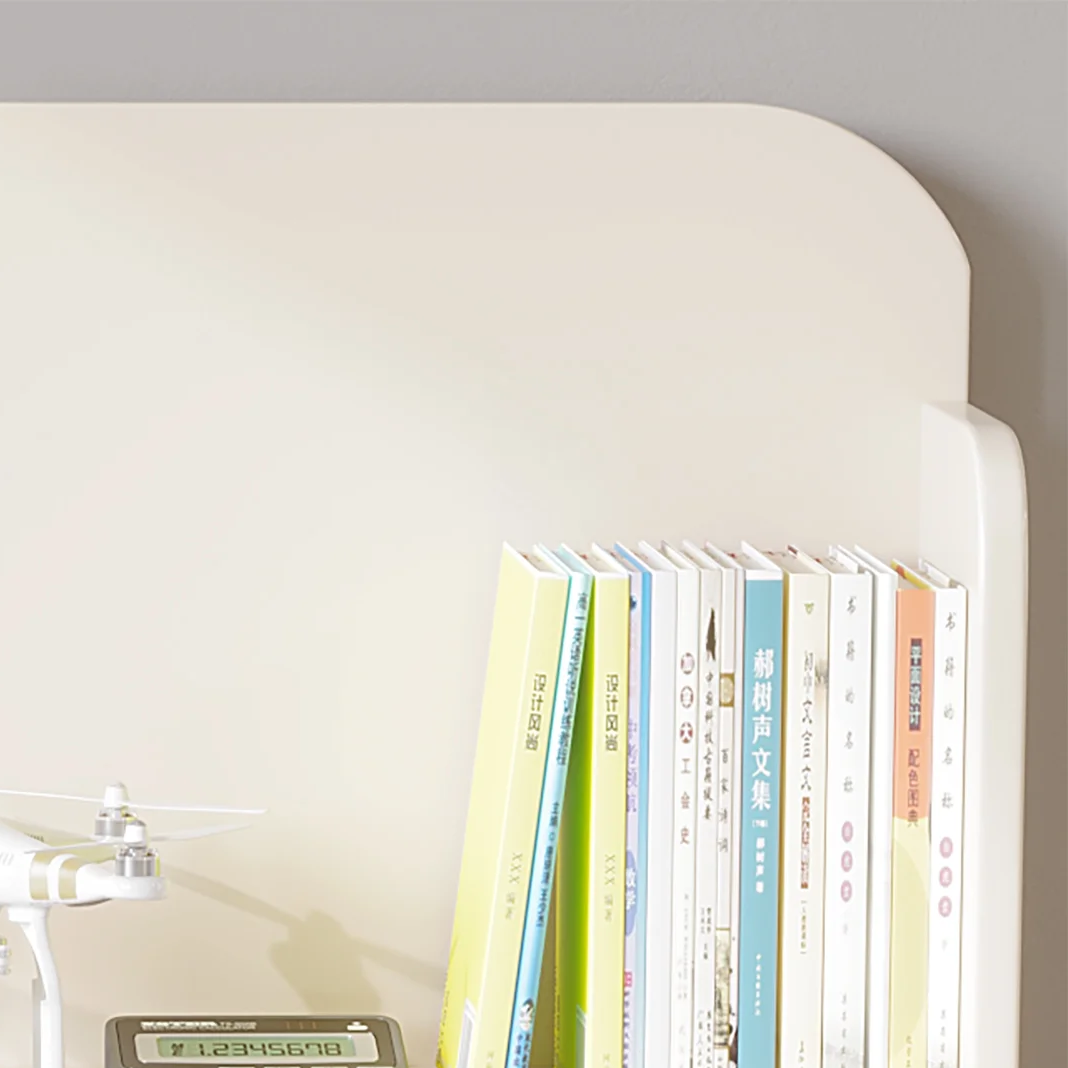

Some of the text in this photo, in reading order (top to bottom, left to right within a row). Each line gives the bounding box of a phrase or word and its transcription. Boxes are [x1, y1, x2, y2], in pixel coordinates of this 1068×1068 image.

[525, 673, 548, 752] 设计风尚
[605, 673, 620, 752] 设计风尚
[751, 648, 775, 811] 郝树声文集
[197, 1042, 342, 1057] 1.2345678
